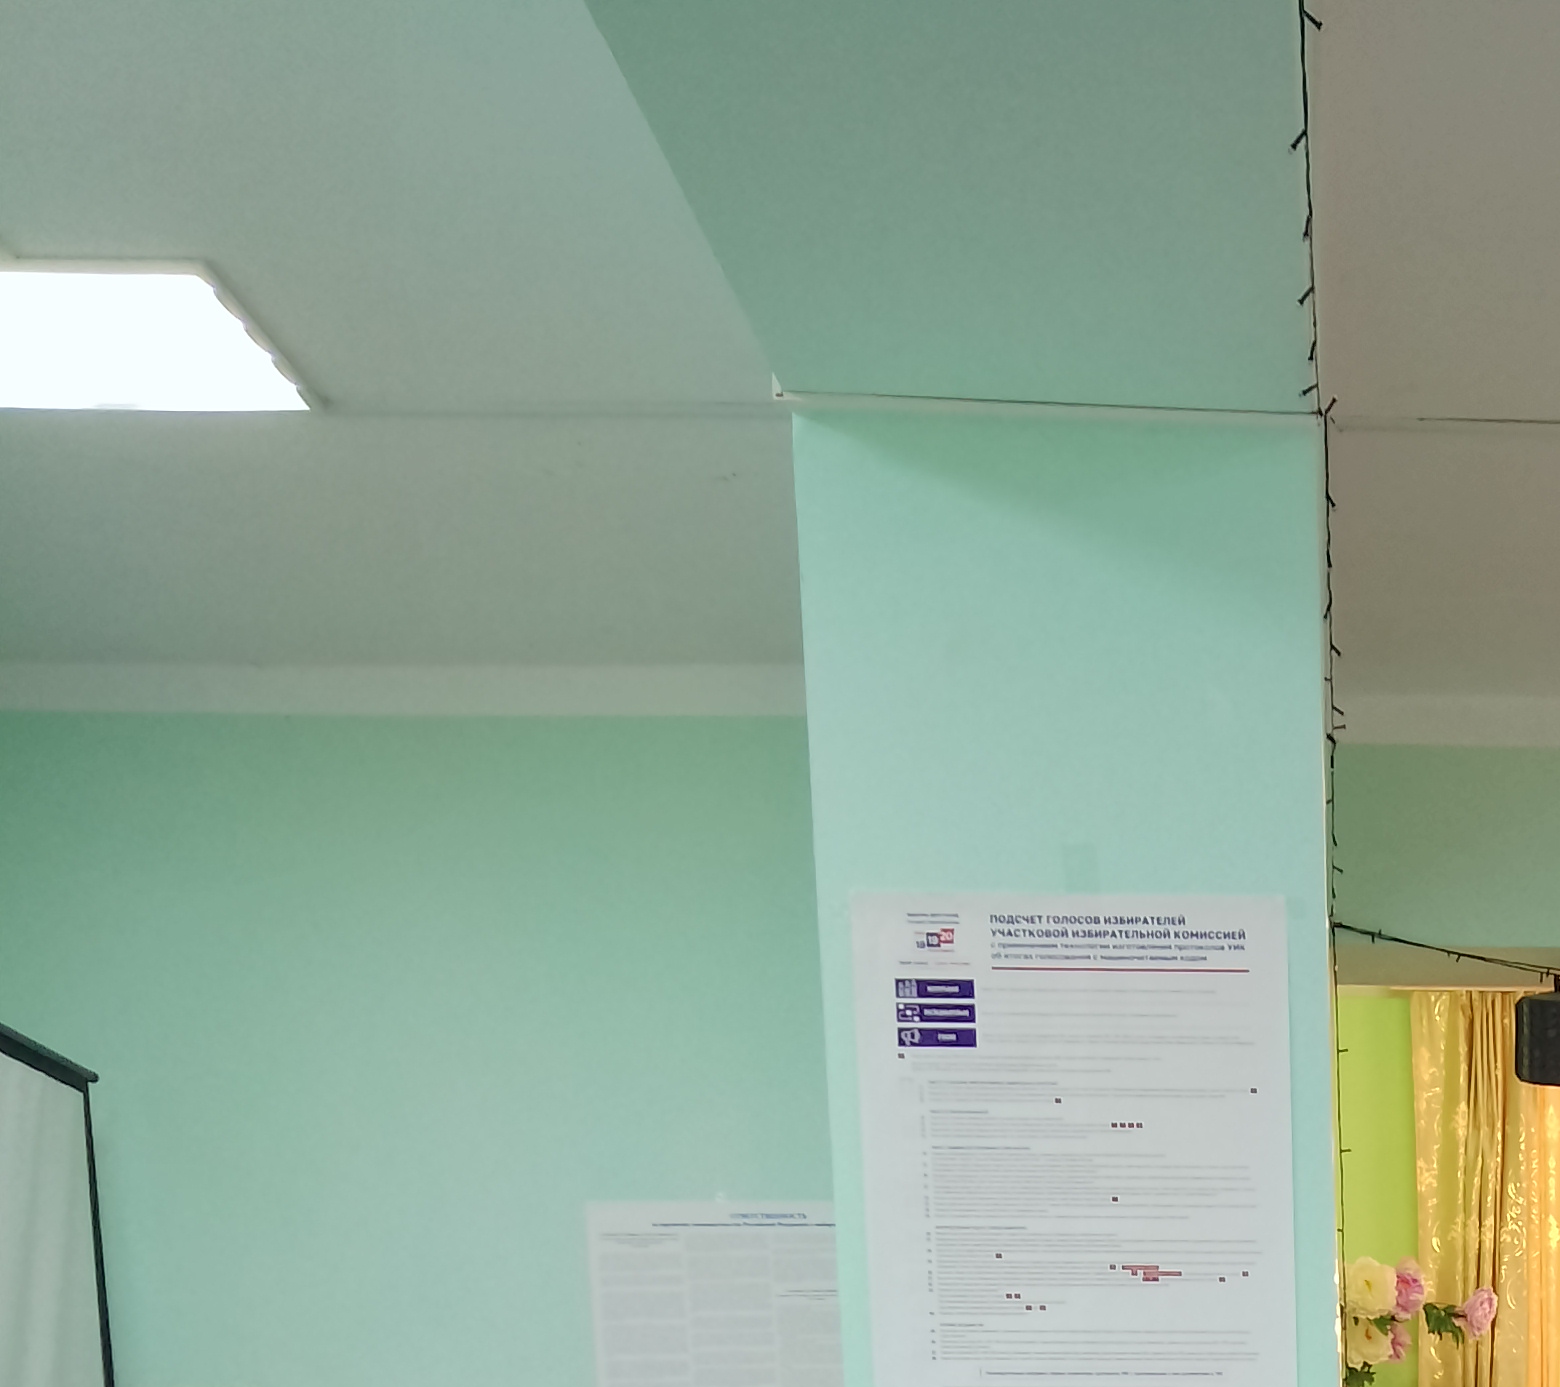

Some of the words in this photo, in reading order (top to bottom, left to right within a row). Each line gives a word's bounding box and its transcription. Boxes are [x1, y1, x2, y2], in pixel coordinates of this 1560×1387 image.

[989, 914, 1043, 925] ПОДСЧЕТ
[1046, 915, 1101, 925] ГОЛОСОВ
[1103, 914, 1186, 926] ИЗБИРАТЕЛЕЙ
[990, 927, 1069, 939] УЧАСТКОВОЙ
[1072, 927, 1171, 940] ИЗБИРАТЕЛЬНОЙ
[1173, 928, 1246, 940] КОМИССИЕЙ
